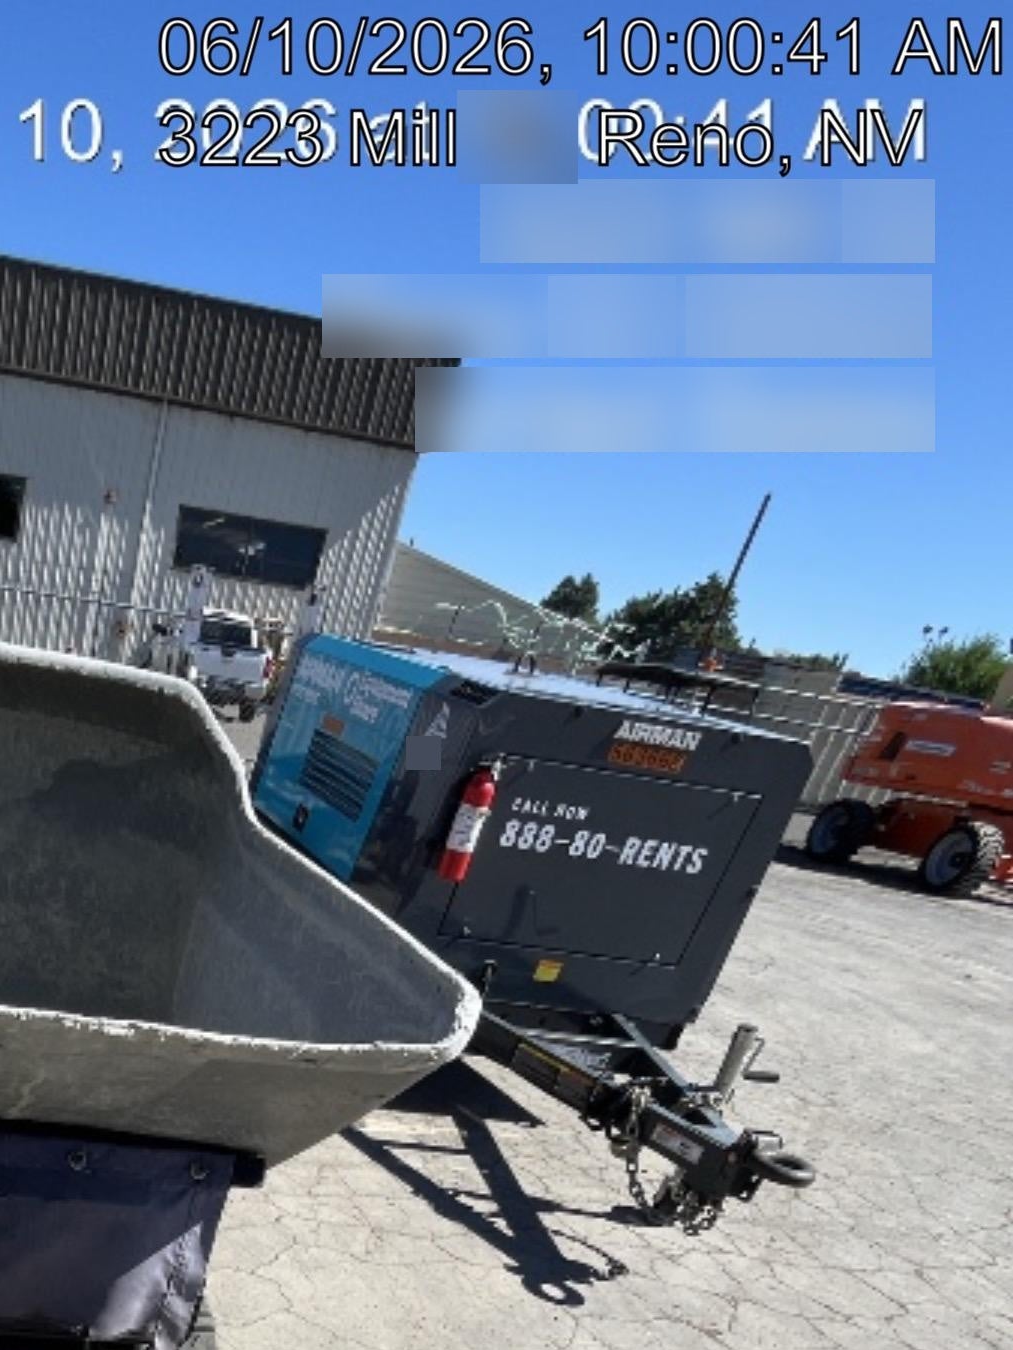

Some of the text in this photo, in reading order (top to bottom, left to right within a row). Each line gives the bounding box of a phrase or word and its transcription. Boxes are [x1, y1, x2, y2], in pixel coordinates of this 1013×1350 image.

[613, 719, 703, 752] AIRMAN
[511, 797, 590, 821] CALL NOW
[499, 818, 709, 875] 888-80-RENTS
